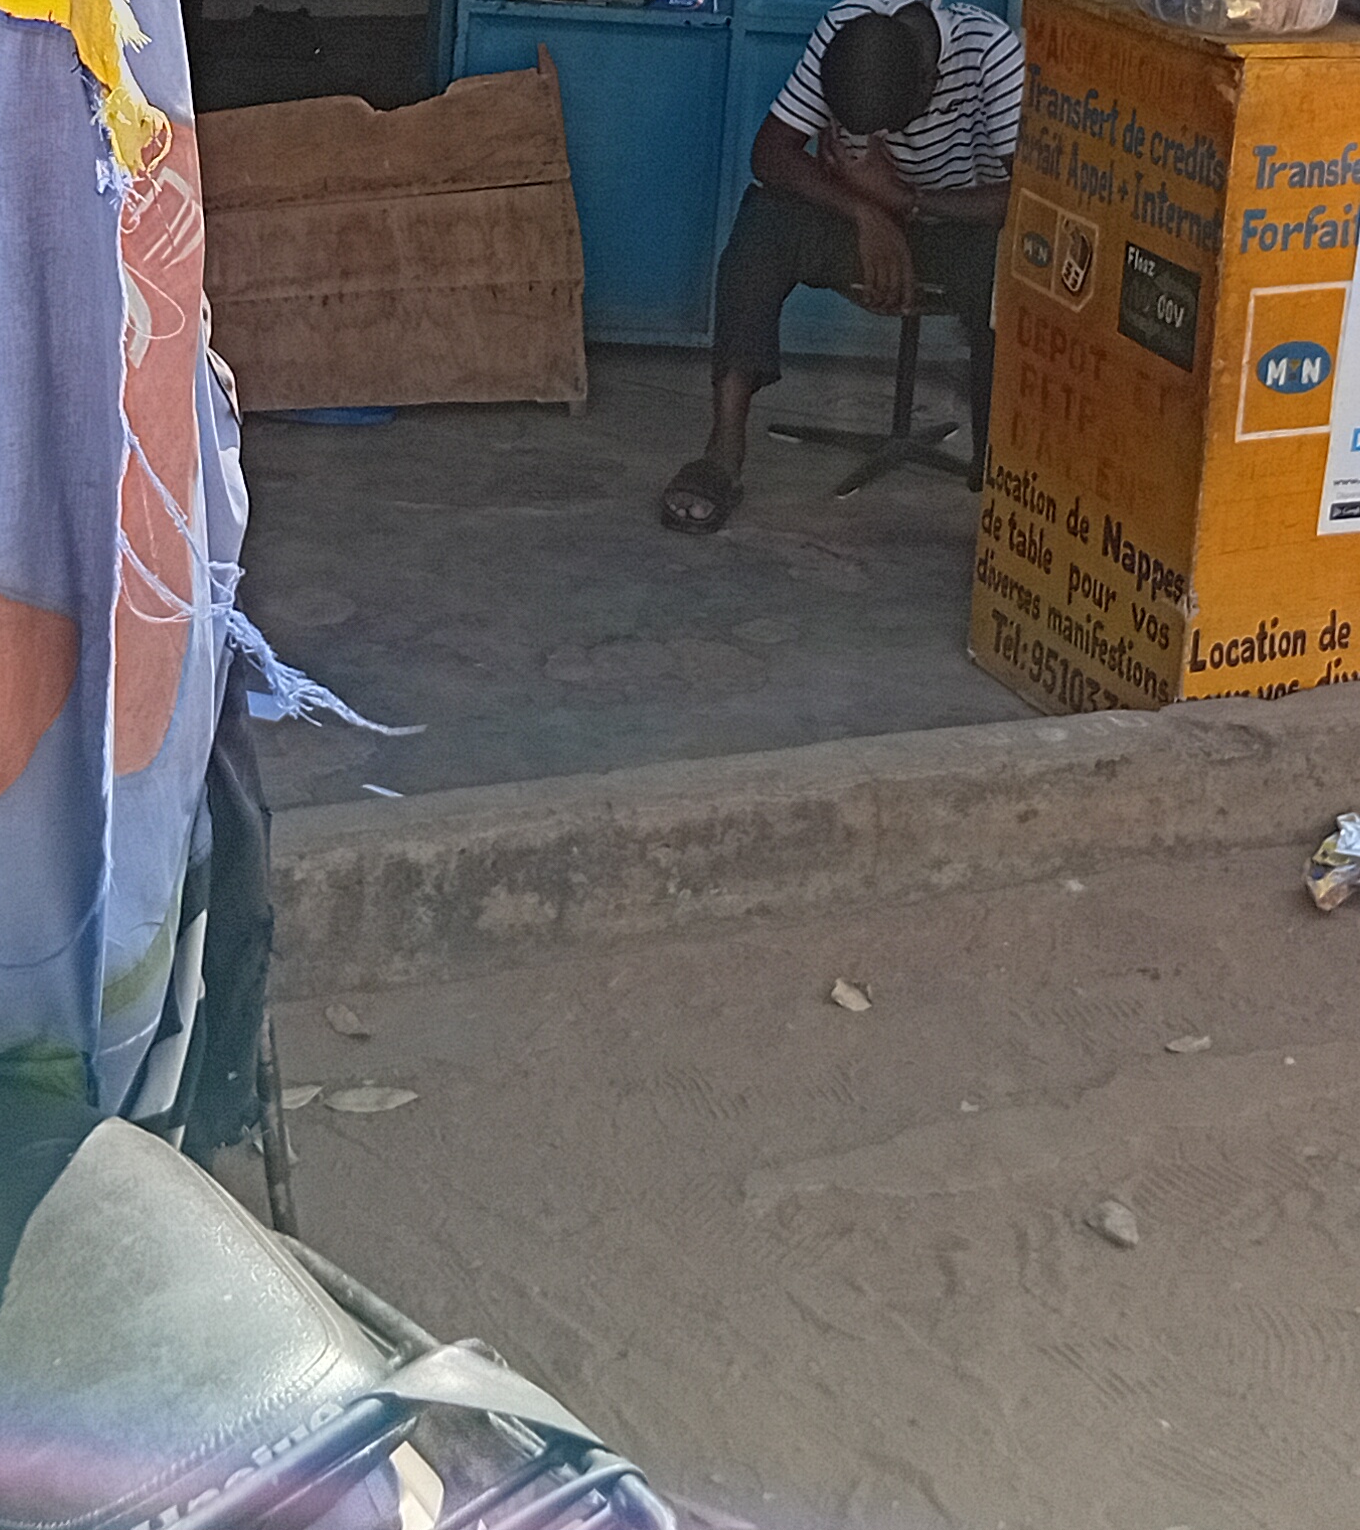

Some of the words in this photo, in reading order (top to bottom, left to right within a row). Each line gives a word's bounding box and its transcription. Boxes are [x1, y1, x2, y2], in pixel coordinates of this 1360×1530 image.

[1027, 63, 1119, 147] Transfert
[1122, 107, 1145, 159] de
[981, 499, 1002, 542] de
[1008, 512, 1053, 575] table
[1066, 562, 1117, 612] pour
[986, 465, 1057, 524] Location
[1066, 496, 1090, 544] de
[1101, 515, 1186, 603] Nappes
[976, 548, 1041, 620] diverses
[1187, 617, 1307, 673] Location
[1317, 609, 1351, 652] de
